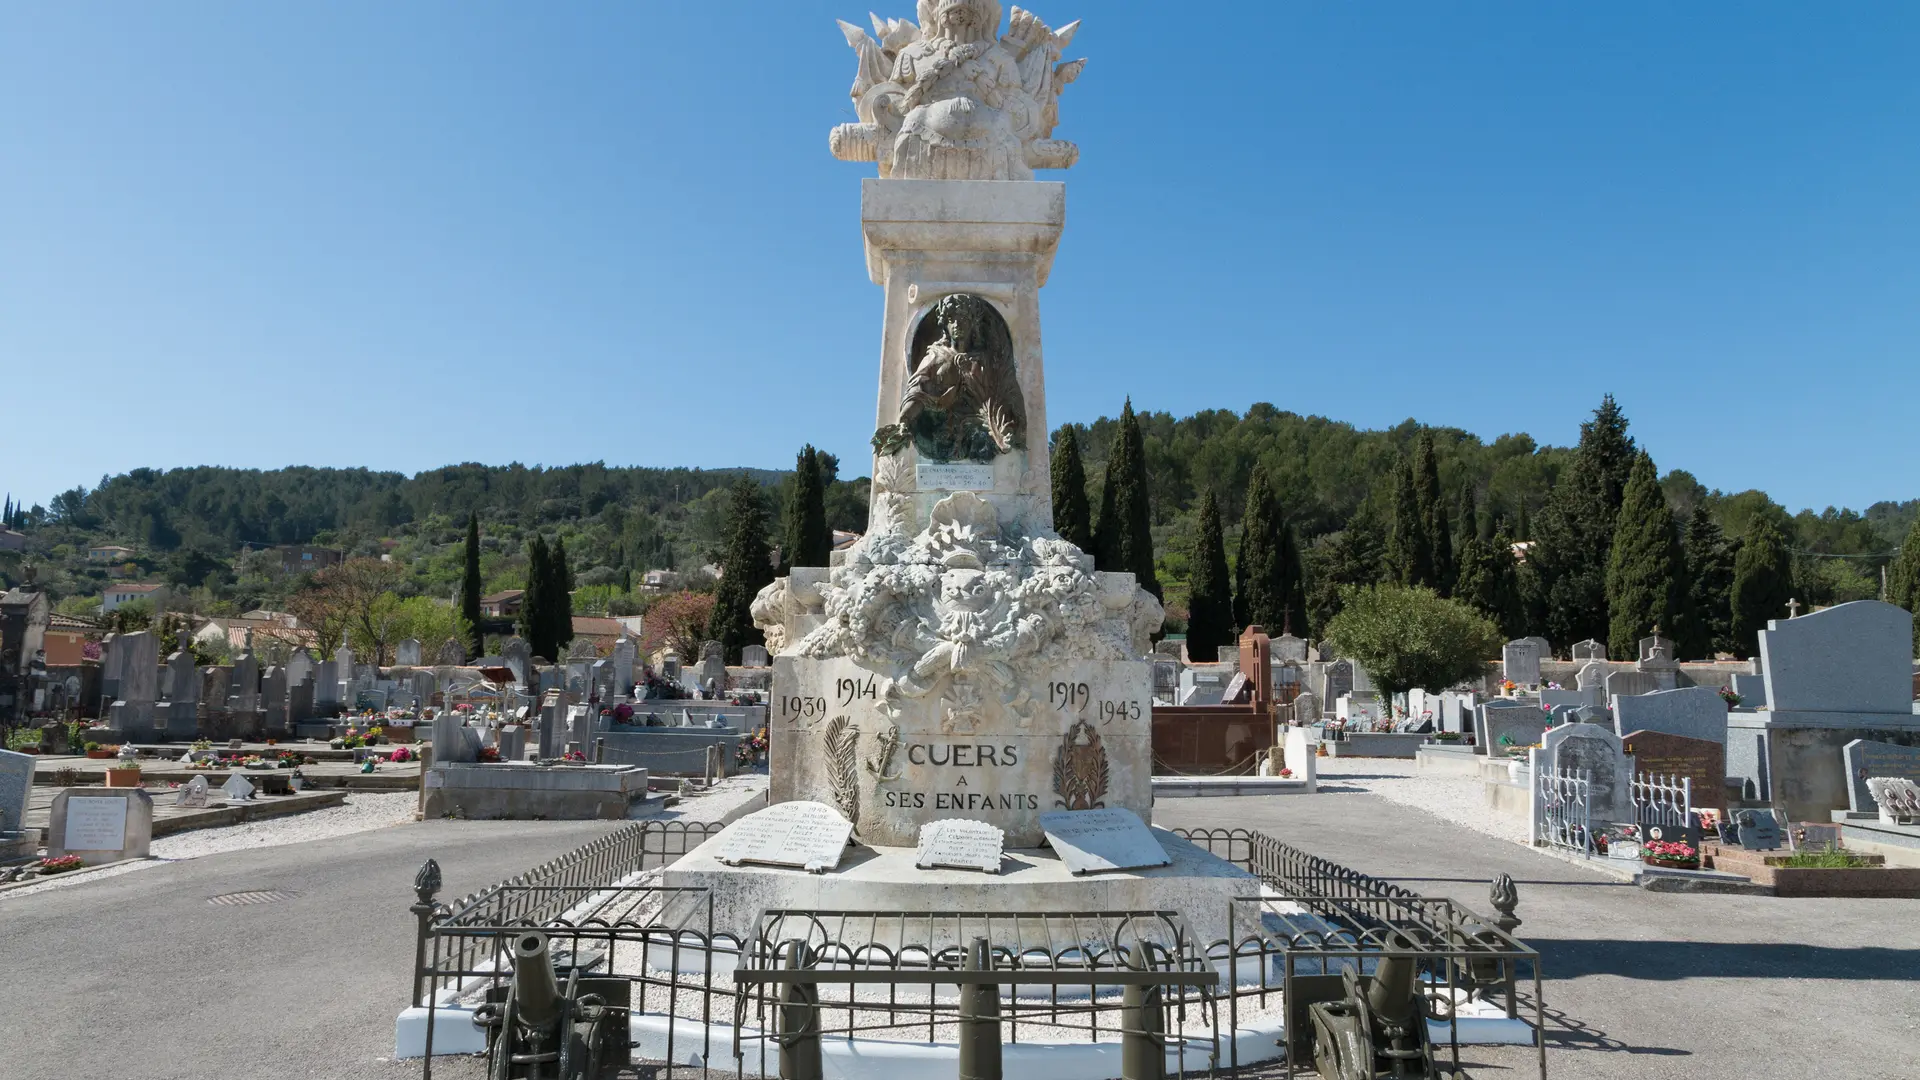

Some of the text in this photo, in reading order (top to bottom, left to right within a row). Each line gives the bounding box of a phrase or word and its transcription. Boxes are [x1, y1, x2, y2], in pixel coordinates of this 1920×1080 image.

[836, 673, 876, 707] 1914
[1048, 682, 1090, 712] 1919
[782, 695, 826, 723] 1939
[1099, 700, 1141, 725] 1945
[908, 744, 1018, 766] CUERS
[956, 775, 968, 786] A
[885, 792, 1038, 810] SES ENFANTS
